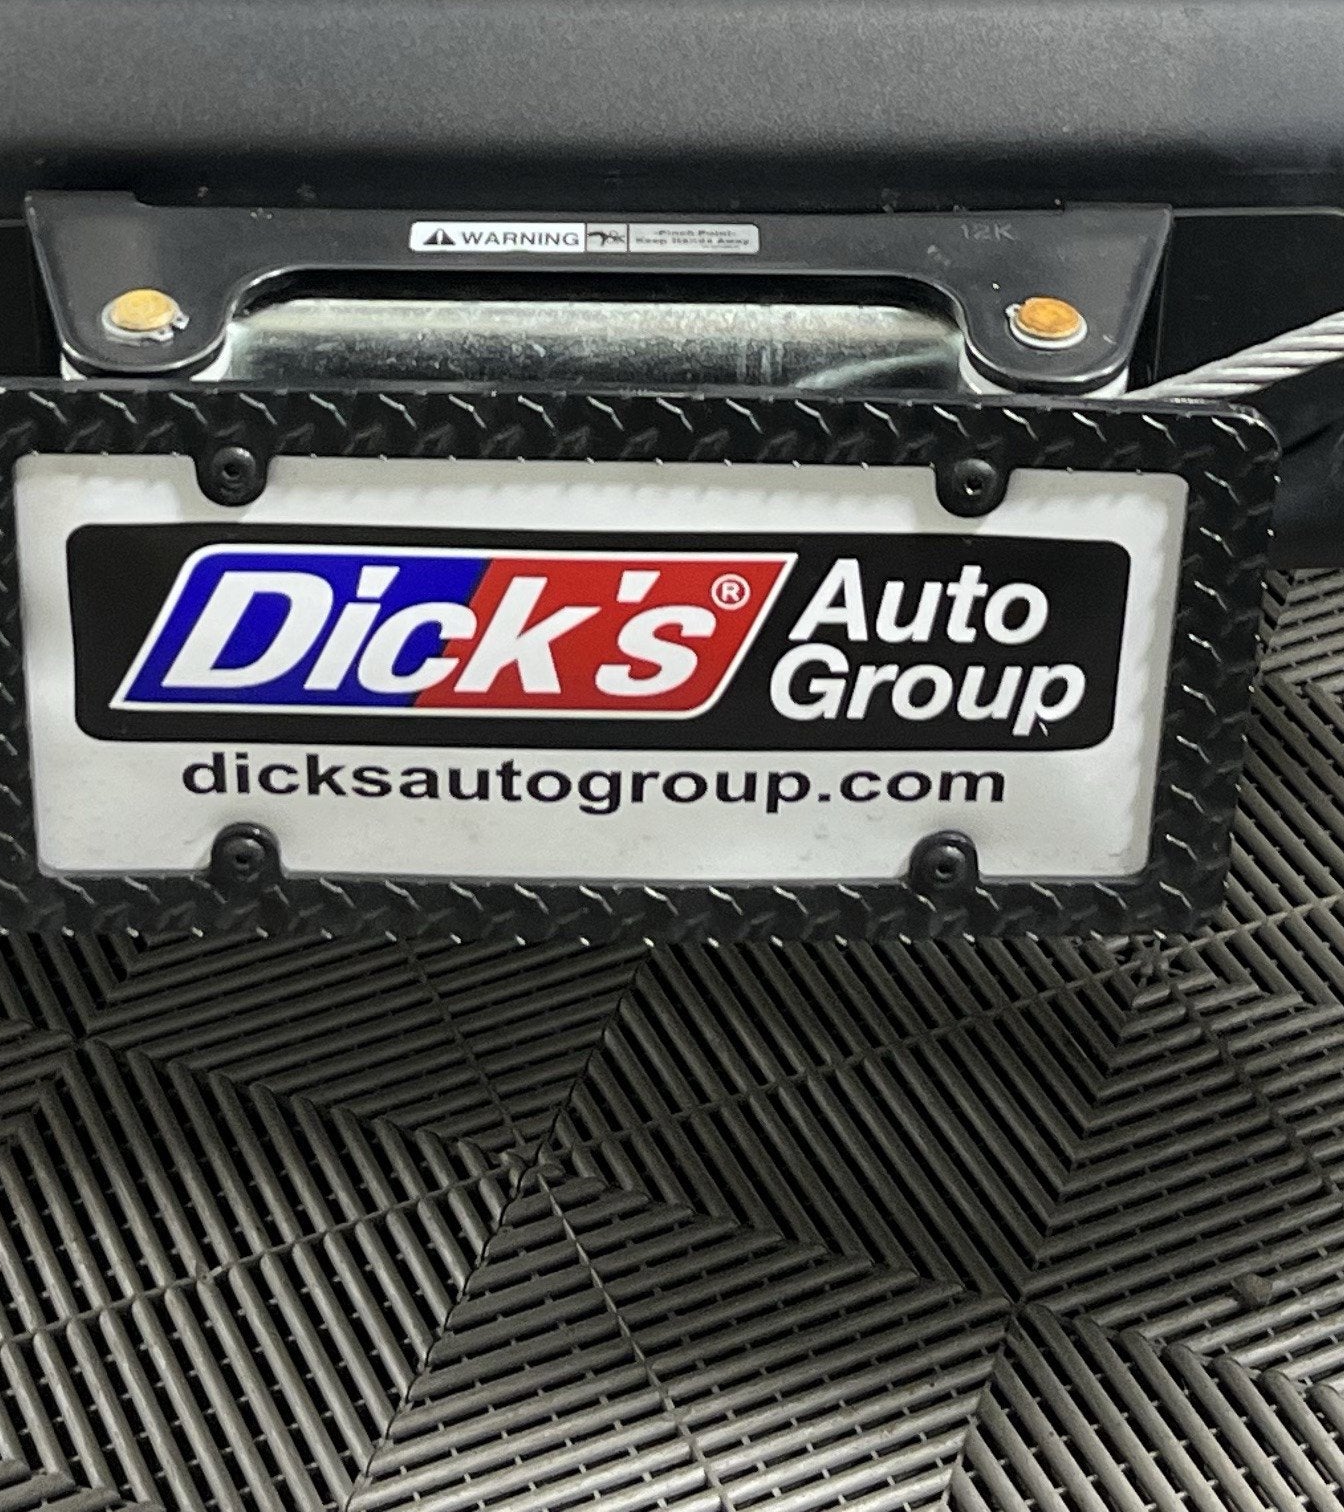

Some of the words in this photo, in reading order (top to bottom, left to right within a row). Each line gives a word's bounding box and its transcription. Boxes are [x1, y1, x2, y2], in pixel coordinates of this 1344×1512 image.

[460, 231, 580, 246] WARNING
[788, 558, 1049, 644] Auto
[770, 642, 1087, 737] Group
[181, 752, 1005, 815] dicksautogroup.com
